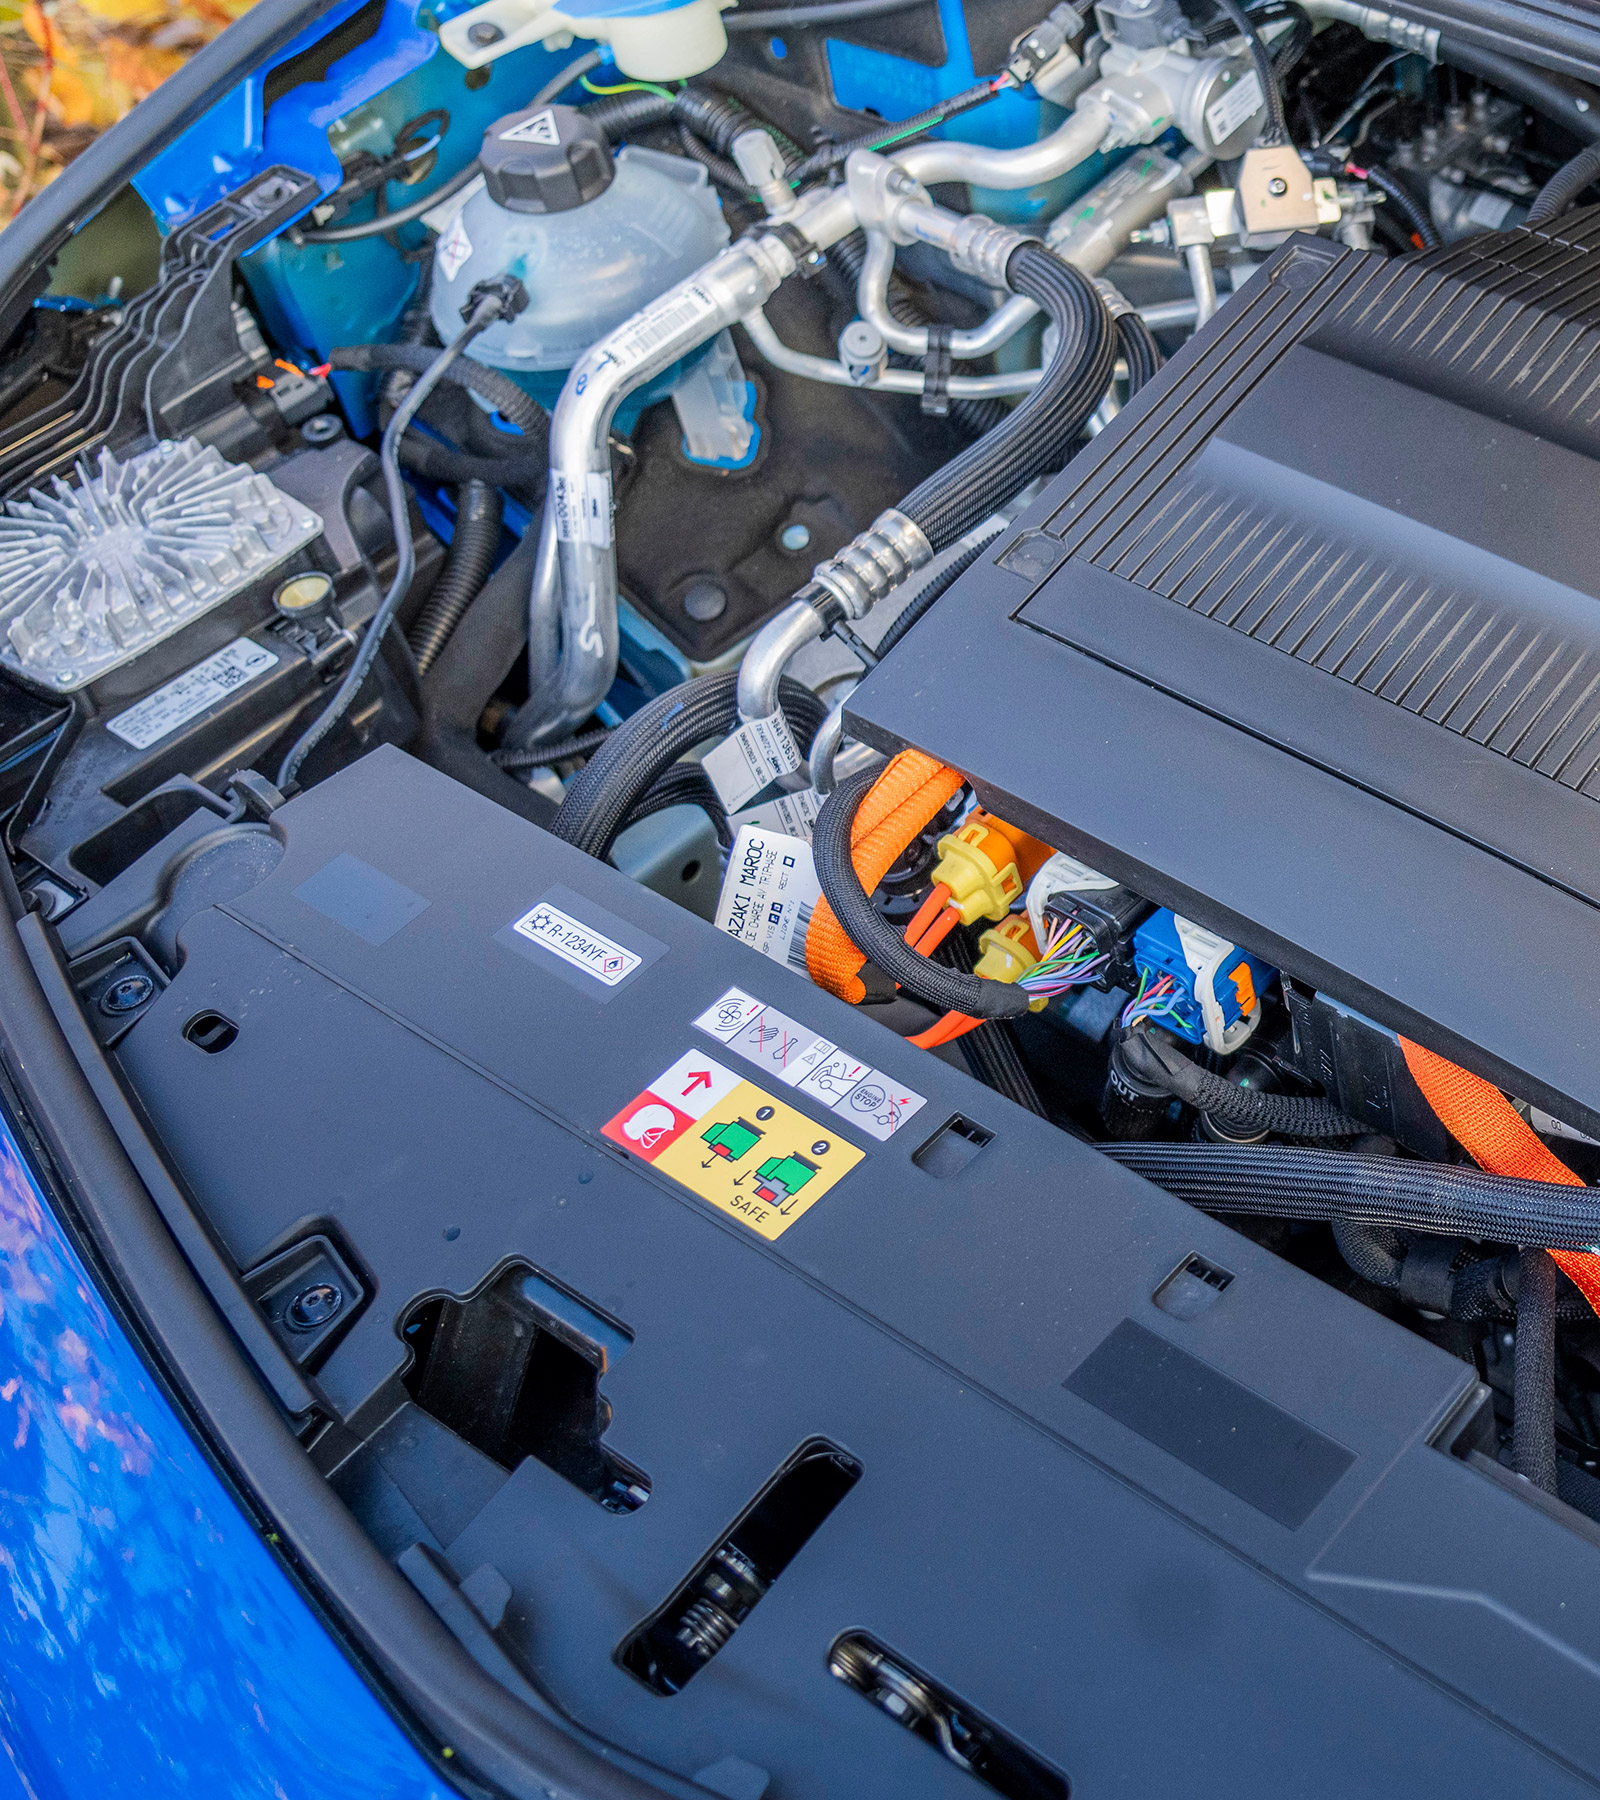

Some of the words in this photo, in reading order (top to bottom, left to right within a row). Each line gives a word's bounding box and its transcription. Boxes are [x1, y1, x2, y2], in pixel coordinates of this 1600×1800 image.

[739, 838, 765, 887] MAROC
[759, 849, 778, 886] TRIPHASE
[757, 888, 768, 900] AV
[748, 901, 765, 929] CHARGE
[780, 916, 790, 940] LIGNE
[547, 923, 608, 961] R-1234YF
[859, 1088, 883, 1104] ENGINE
[1110, 1069, 1139, 1101] OUT
[854, 1092, 877, 1109] STOP
[760, 1109, 770, 1119] 1
[814, 1142, 827, 1154] 2
[730, 1194, 770, 1224] SAFE
